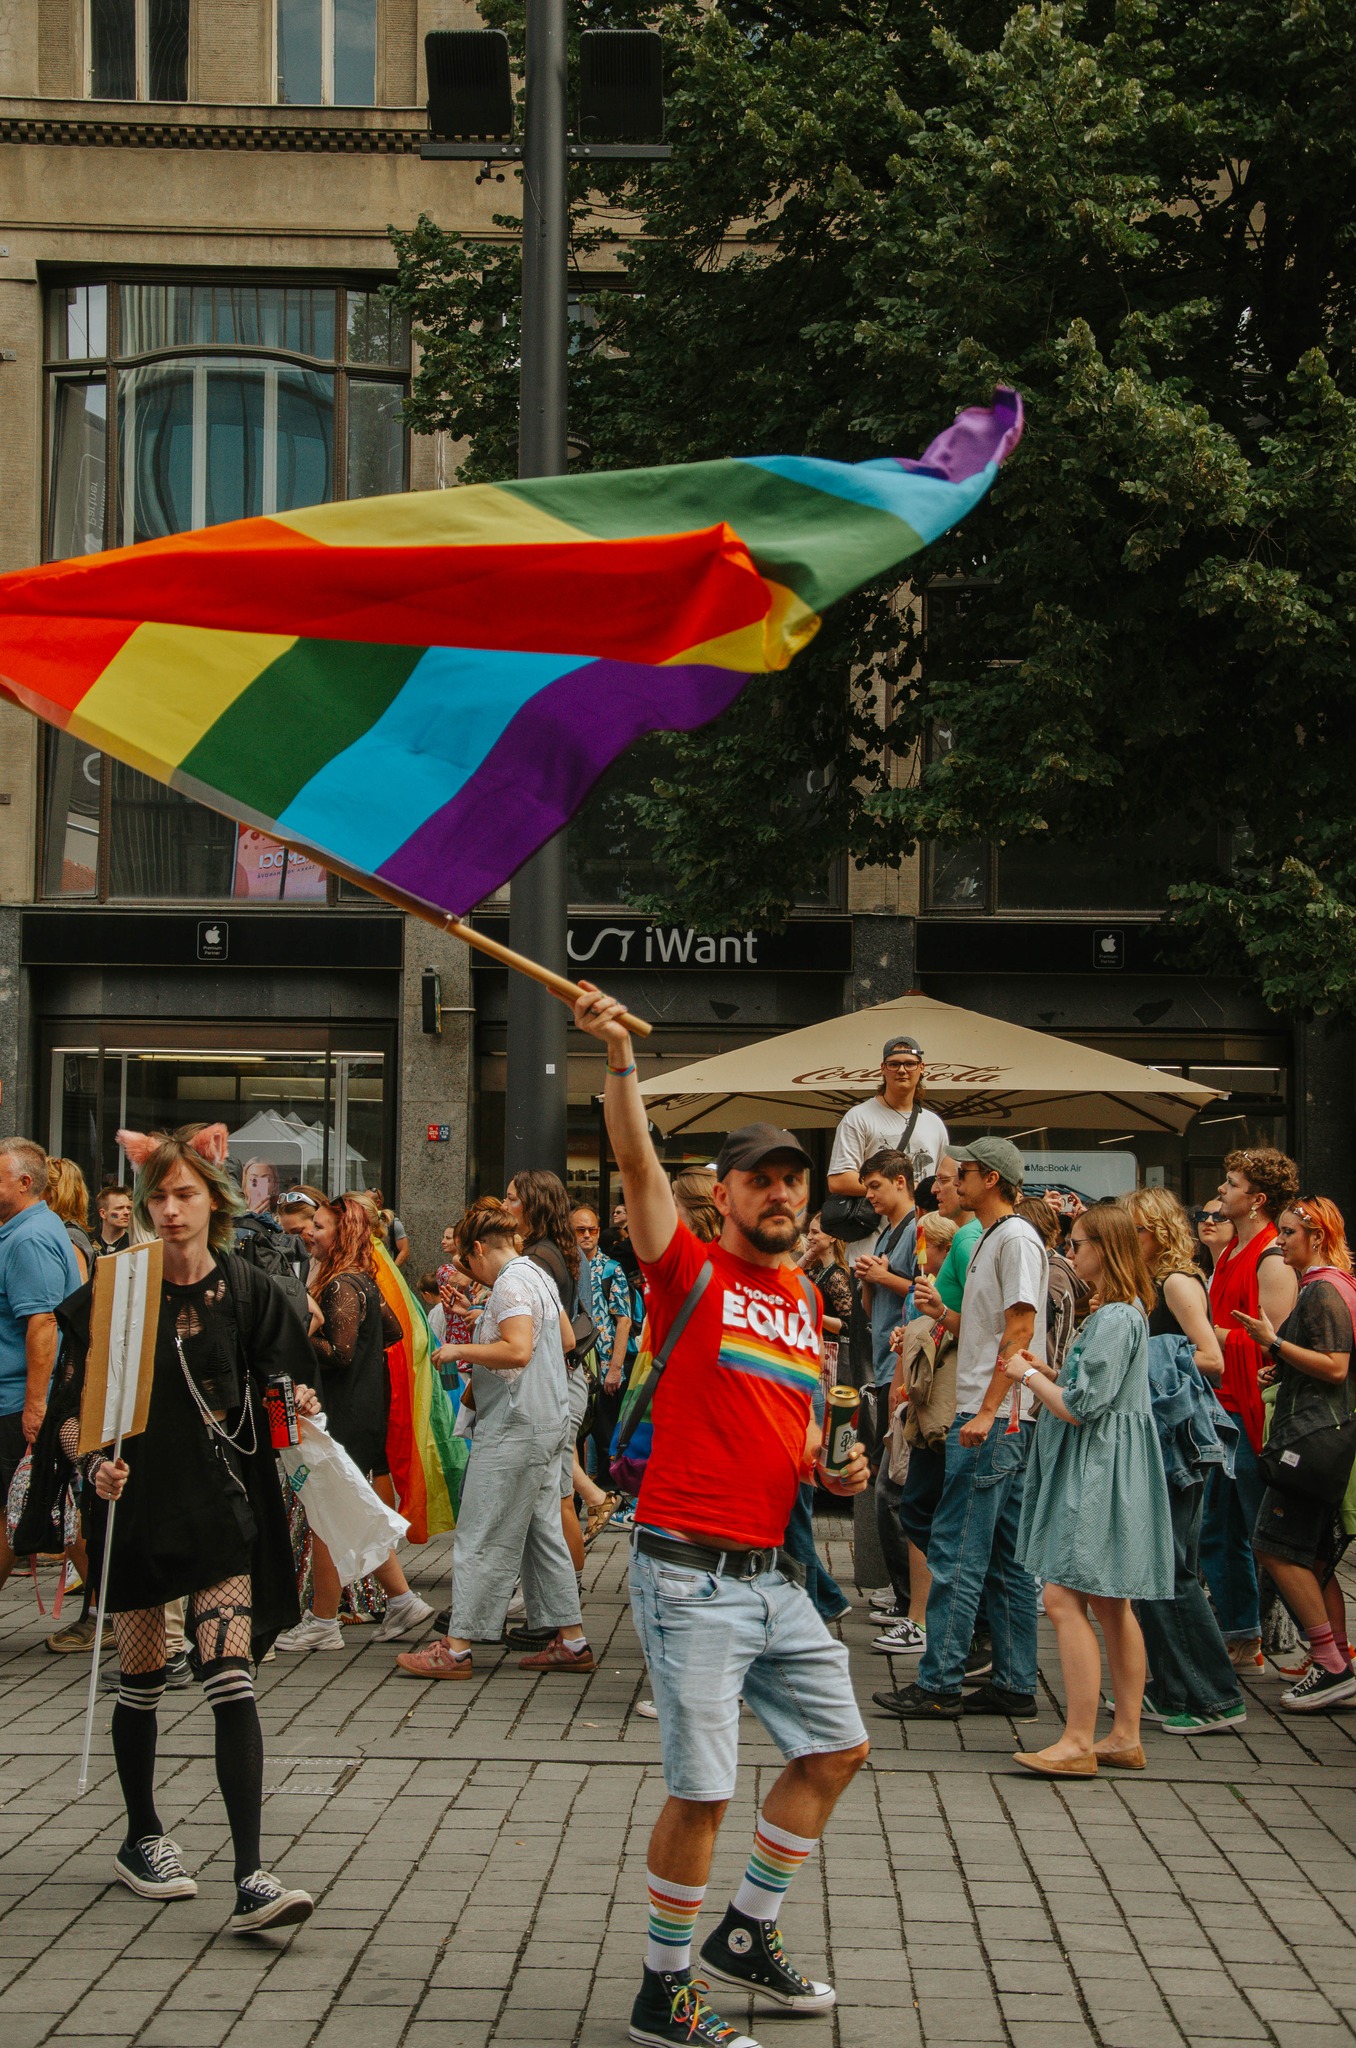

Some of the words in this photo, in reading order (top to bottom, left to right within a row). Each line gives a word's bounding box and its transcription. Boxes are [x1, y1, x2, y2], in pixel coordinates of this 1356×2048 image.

[645, 926, 758, 964] iWant
[1030, 1164, 1069, 1172] MacBook
[1070, 1164, 1082, 1172] Air
